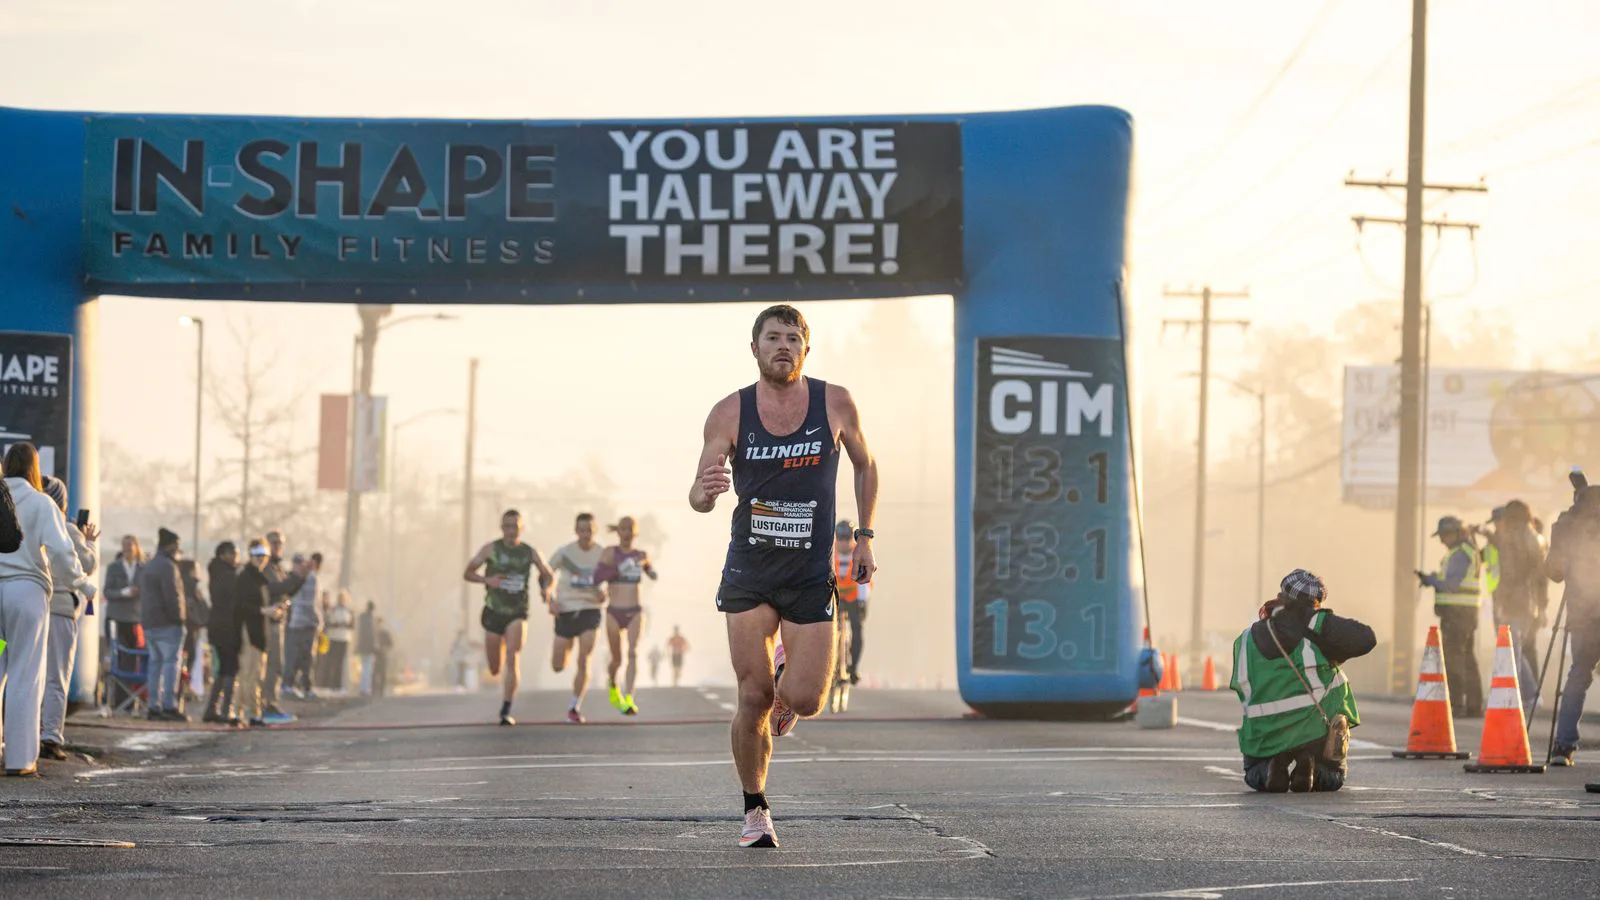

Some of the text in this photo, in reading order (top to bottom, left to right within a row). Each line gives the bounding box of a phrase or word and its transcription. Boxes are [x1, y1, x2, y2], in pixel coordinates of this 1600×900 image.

[608, 128, 897, 171] YOU ARE
[111, 137, 558, 222] IN-SHAPE
[608, 172, 898, 221] HALFWAY
[112, 231, 556, 264] FAMILY FITNESS
[608, 223, 900, 276] THERE!
[989, 379, 1114, 437] CIM
[746, 441, 822, 460] ILLINOIS
[783, 455, 821, 469] ELITE
[989, 445, 1110, 506] 13.1
[752, 519, 811, 532] LUSTGARTEN
[775, 538, 800, 548] ELITE
[987, 520, 1108, 582] 13.1
[984, 599, 1107, 662] 13.1
